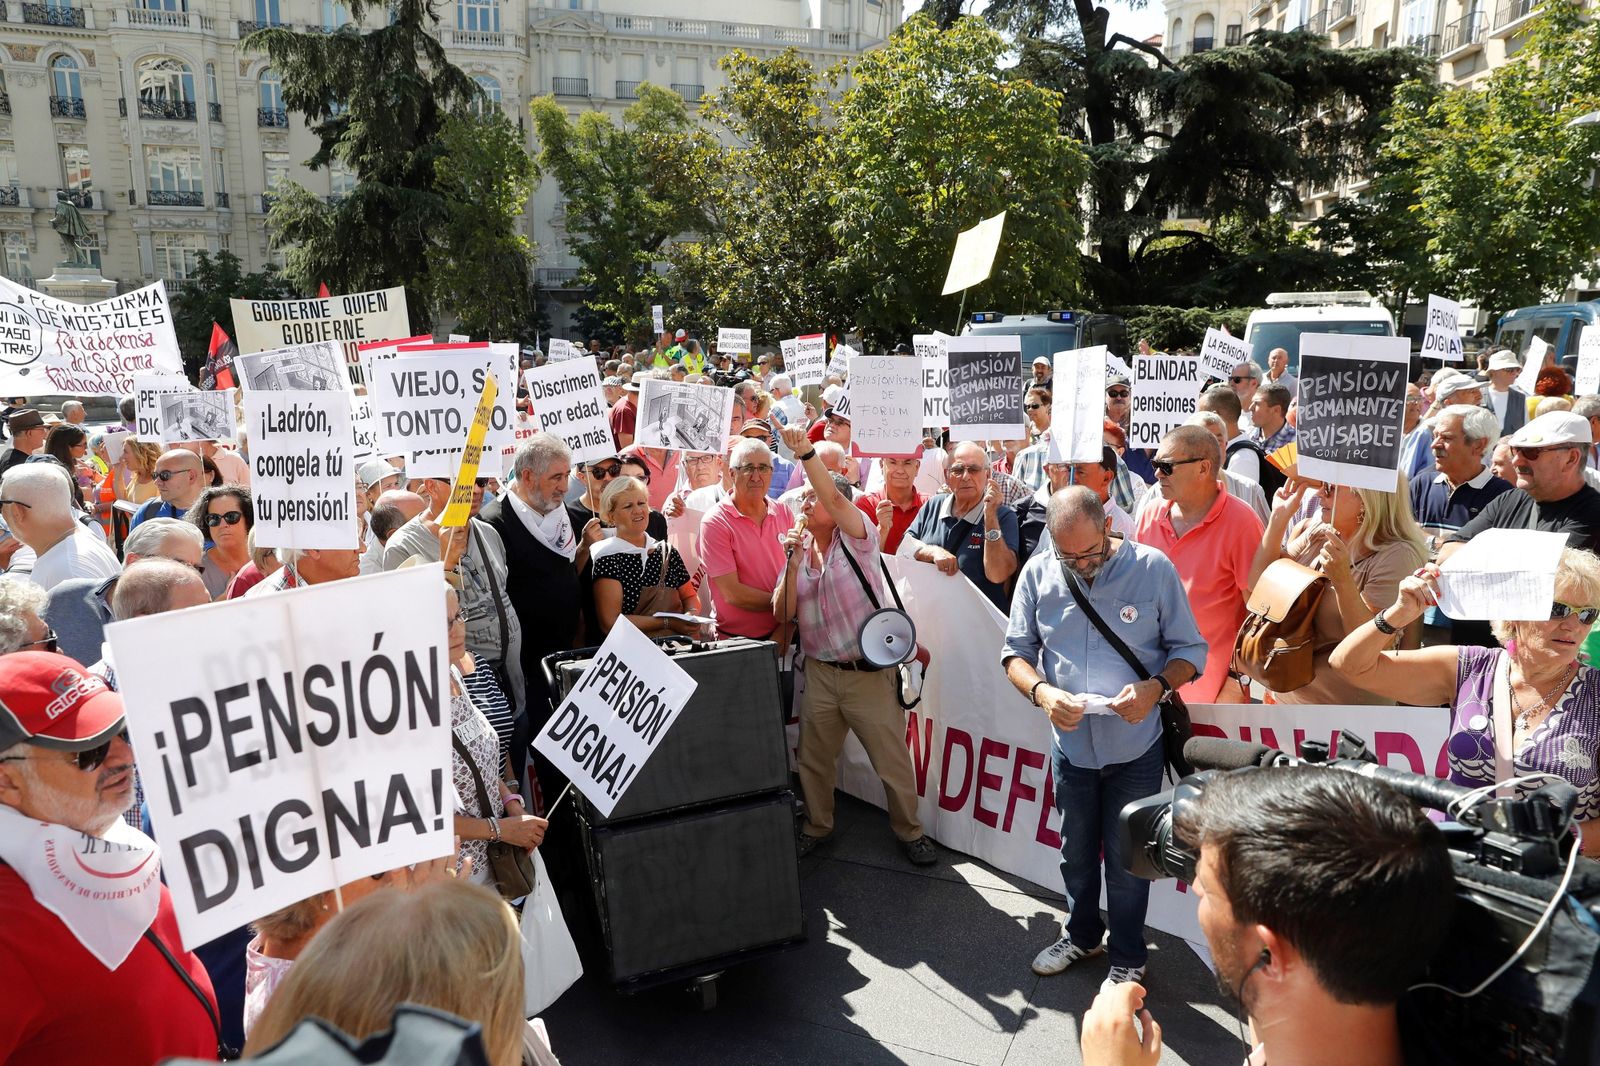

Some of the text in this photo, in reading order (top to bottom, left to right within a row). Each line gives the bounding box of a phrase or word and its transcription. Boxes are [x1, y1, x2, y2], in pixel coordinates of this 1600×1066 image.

[13, 312, 30, 326] UN
[251, 290, 388, 322] GOBIERNE QUIEN
[1429, 308, 1459, 332] ¡PENSIÓN
[282, 317, 365, 345] GOBIERNE
[1425, 332, 1462, 355] DIGNA!
[0, 342, 37, 356] TRAS!
[797, 342, 825, 353] Discrimen
[1207, 336, 1249, 363] LA PENSIÓN
[949, 352, 1016, 383] PENSIÓN
[1133, 359, 1198, 385] ¡BLINDAR
[1202, 353, 1234, 375] MI DEREC
[390, 369, 466, 399] VIEJO,
[531, 372, 597, 400] Discrimen
[949, 375, 1021, 402] PERMANENTE
[1300, 361, 1400, 399] PENSIÓN
[881, 390, 895, 400] DE
[950, 394, 1020, 421] REVISABLE
[1133, 391, 1196, 417] pensiones
[261, 402, 332, 441] ¡Ladrón,
[381, 407, 468, 438] TONTO,
[540, 397, 604, 432] por edad,
[966, 411, 1005, 423] CON IPC
[1299, 396, 1403, 426] PERMANENTE
[583, 426, 611, 447] más.
[1131, 422, 1161, 444] POR
[1299, 422, 1398, 451] REVISABLE
[256, 446, 343, 485] congela tú
[1315, 448, 1369, 460] CON IPC
[257, 491, 349, 528] tu pensión!
[578, 651, 673, 746] ¡PENSIÓN
[154, 632, 442, 816] ¡PENSIÓN
[547, 701, 637, 801] DIGNA!
[179, 768, 445, 914] DIGNA!
